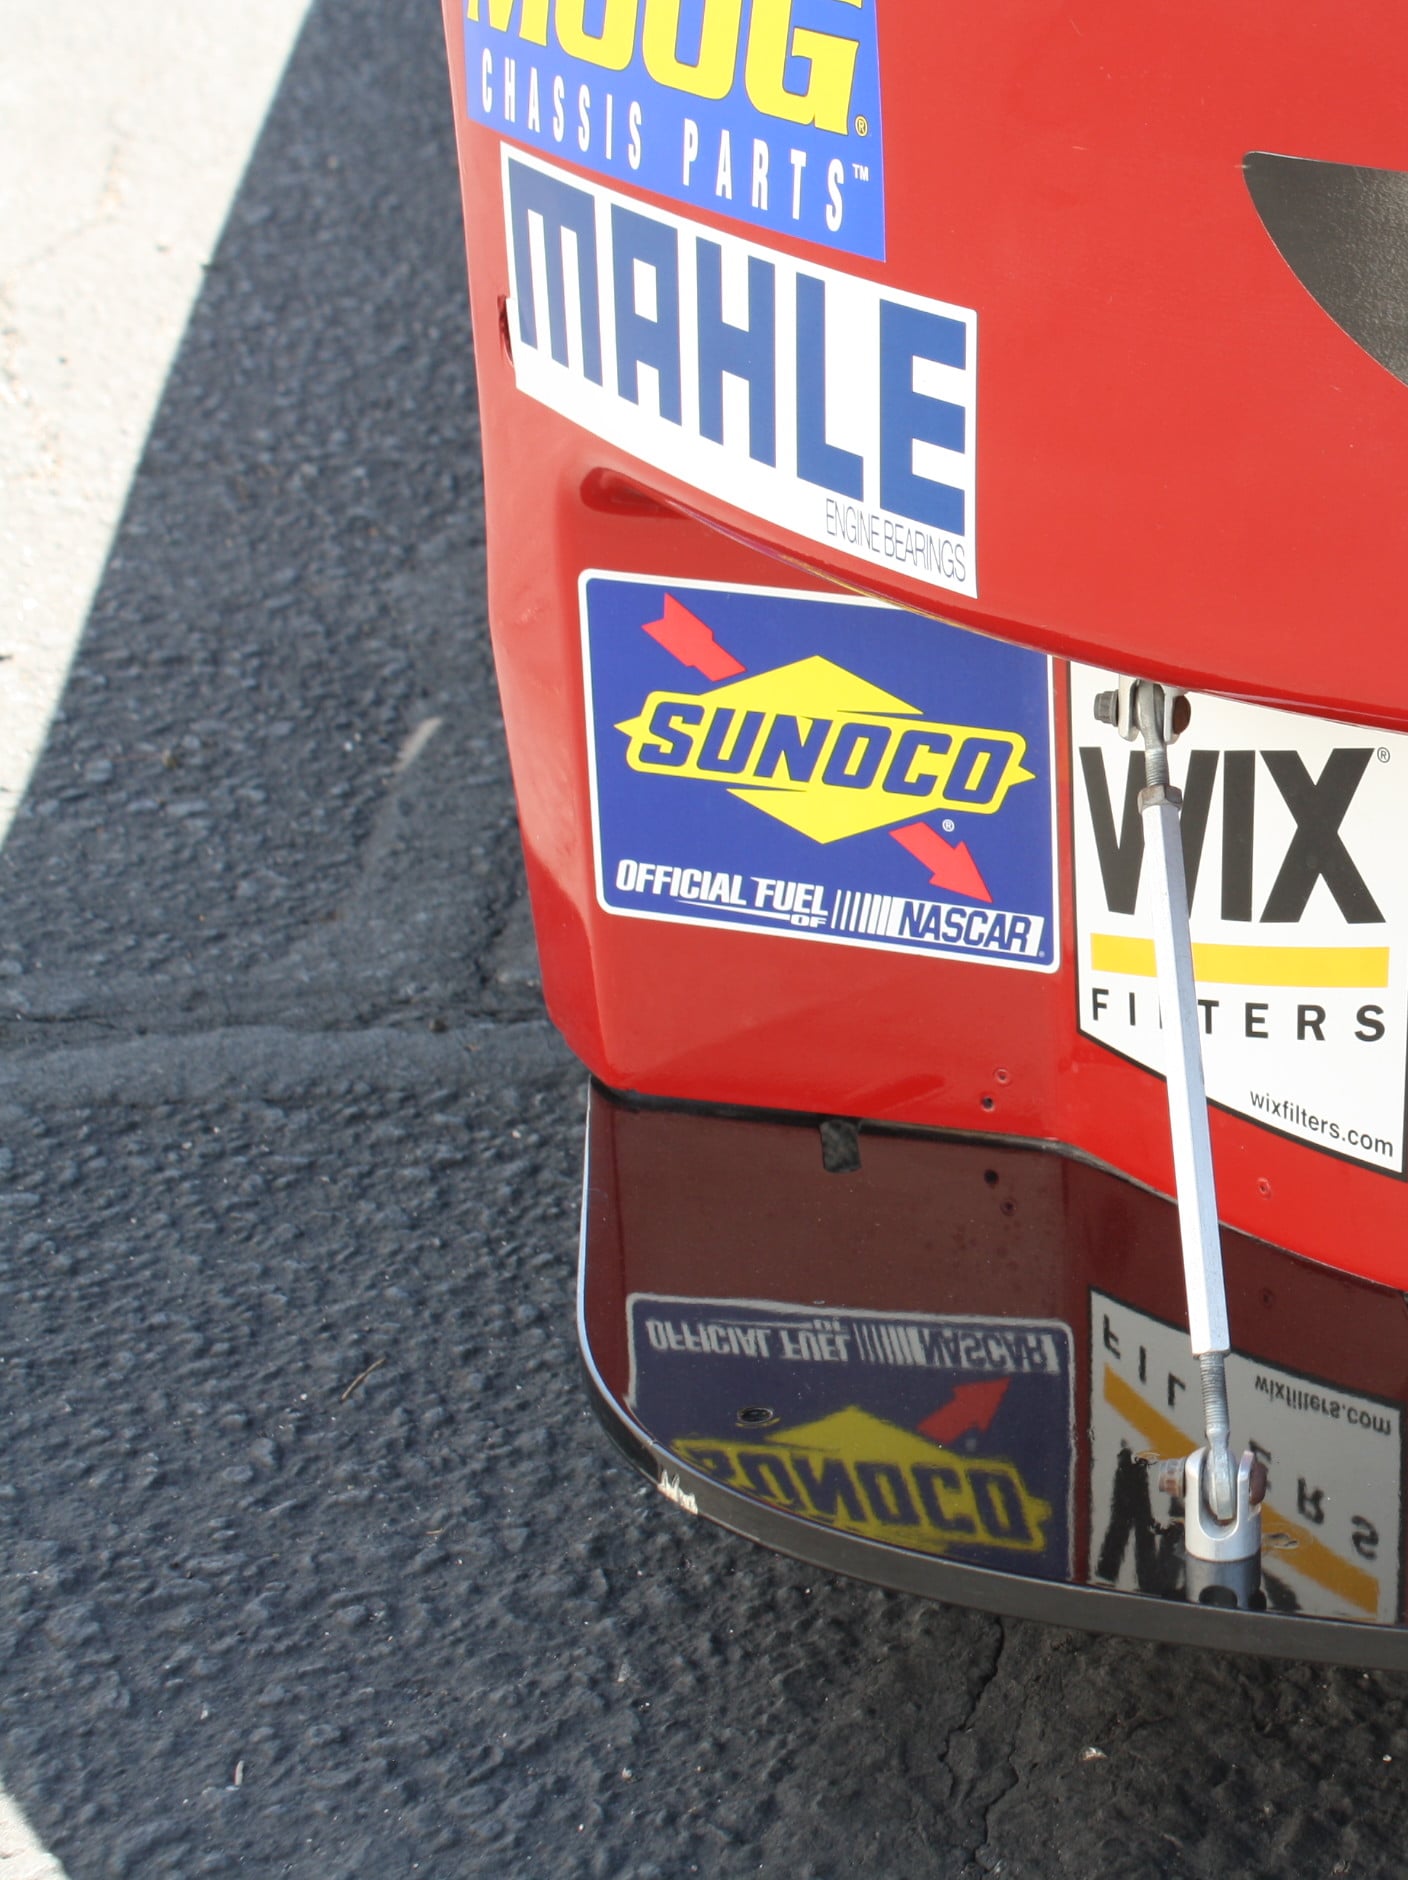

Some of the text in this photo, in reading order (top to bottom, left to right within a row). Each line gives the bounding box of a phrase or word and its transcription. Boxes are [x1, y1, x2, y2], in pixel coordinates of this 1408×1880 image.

[467, 0, 860, 136] OOG
[481, 48, 642, 170] CHASSIS
[507, 157, 966, 537] MAHLE
[826, 498, 966, 582] ENGINE BEARINGS
[638, 701, 1014, 805] SUNOCO
[1079, 747, 1387, 924] WIX
[616, 859, 829, 916] OFFICIAL FUEL
[790, 914, 828, 929] OF
[898, 900, 1032, 954] NASCAR
[1092, 987, 1386, 1042] FITERS
[1250, 1090, 1394, 1158] wixfilters.com
